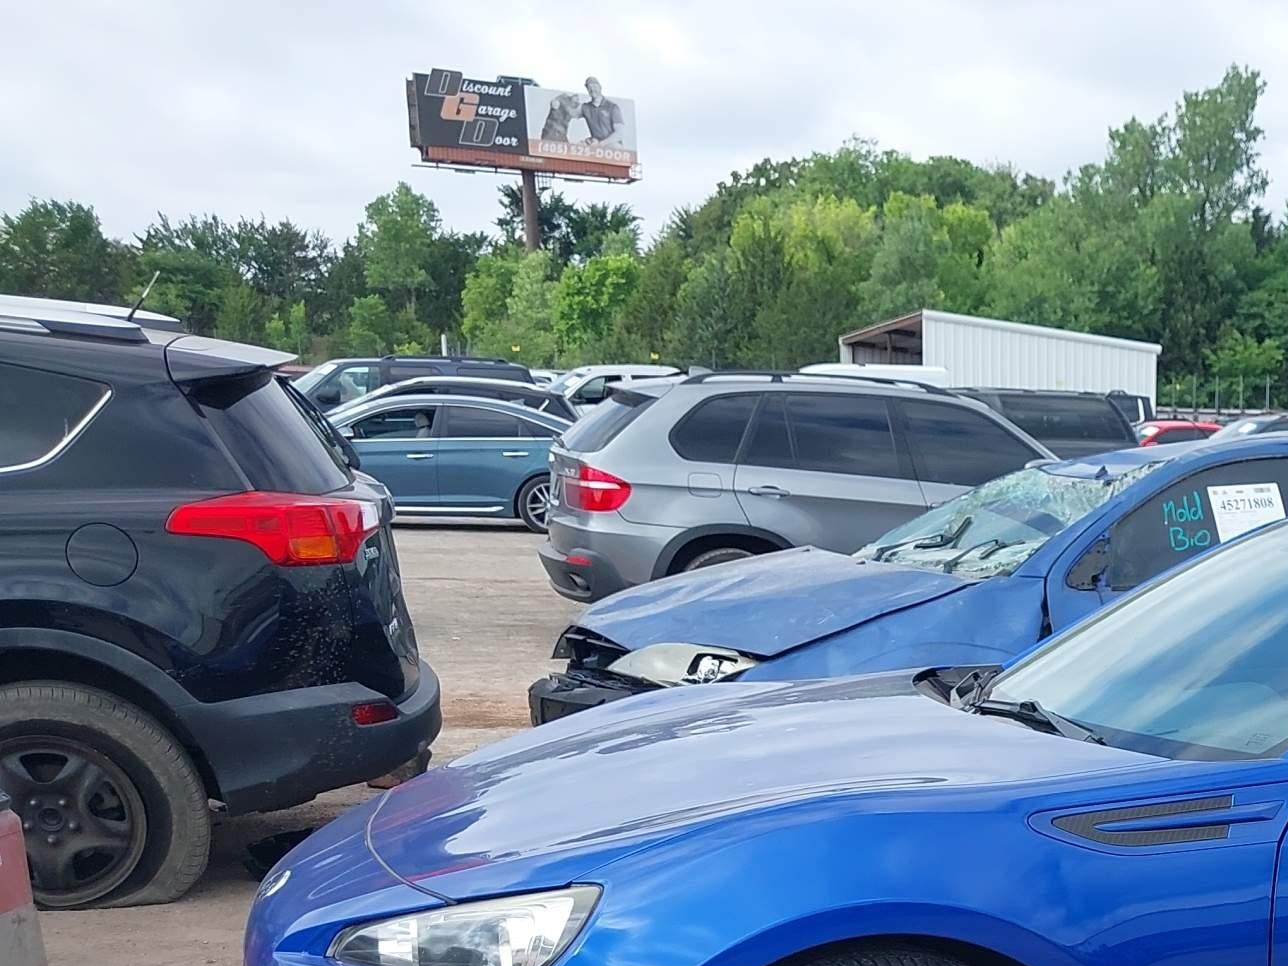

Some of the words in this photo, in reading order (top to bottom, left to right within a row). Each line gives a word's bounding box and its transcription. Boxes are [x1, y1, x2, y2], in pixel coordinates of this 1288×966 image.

[424, 68, 512, 97] Discount
[440, 92, 518, 122] Garage
[459, 116, 518, 147] Door
[1162, 490, 1204, 523] Mold
[1220, 497, 1275, 511] 45271808
[1169, 526, 1211, 551] Bio
